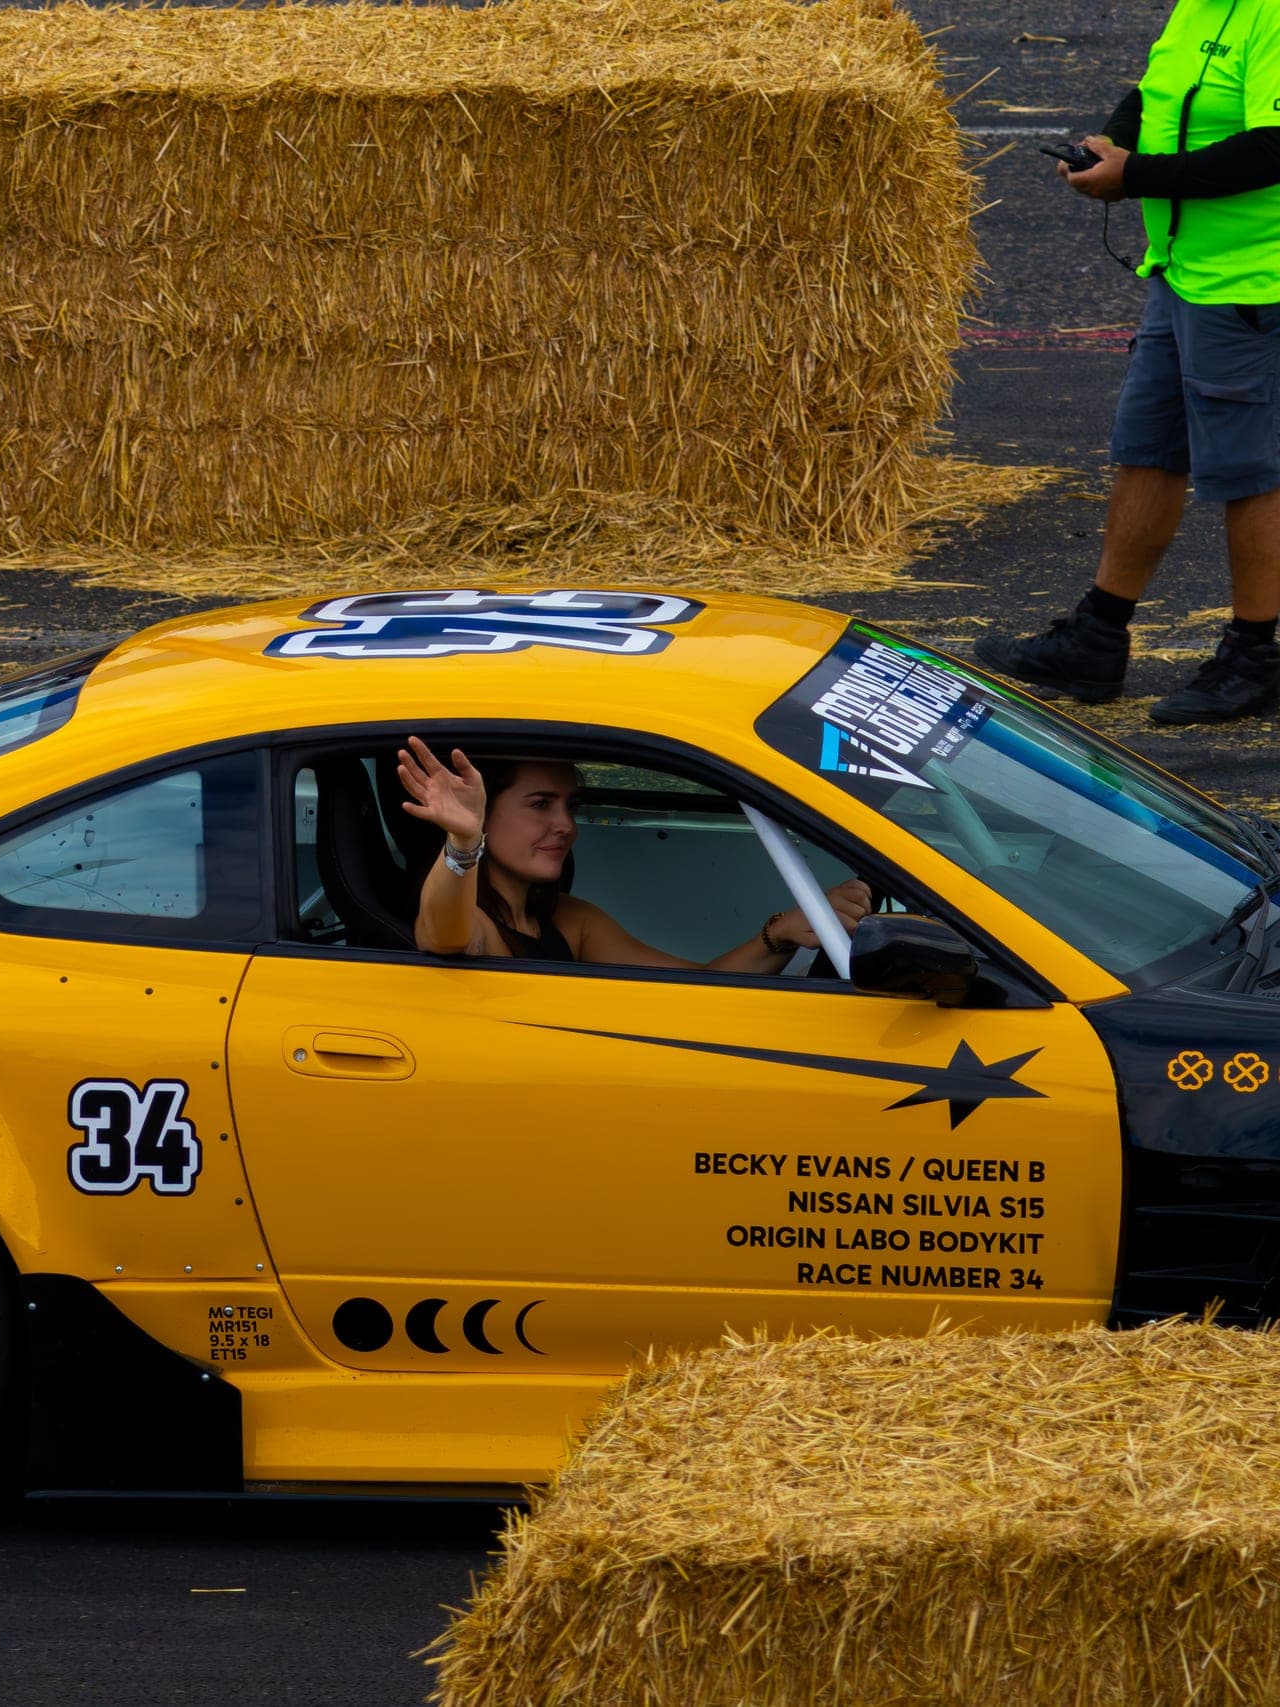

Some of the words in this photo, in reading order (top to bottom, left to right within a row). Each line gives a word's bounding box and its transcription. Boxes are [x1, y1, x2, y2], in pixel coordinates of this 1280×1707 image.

[1199, 39, 1232, 59] CREW
[70, 1081, 199, 1193] 34
[695, 1152, 787, 1176] BECKY
[797, 1155, 891, 1179] EVANS
[899, 1156, 915, 1182] /
[923, 1158, 1019, 1182] QUEEN
[1029, 1161, 1045, 1183] B
[788, 1191, 893, 1215] NISSAN
[903, 1193, 991, 1217] SILVIA
[1000, 1196, 1044, 1219] S15
[726, 1225, 826, 1249] ORIGIN
[836, 1228, 910, 1251] LABO
[919, 1230, 1044, 1254] BODYKIT
[797, 1262, 872, 1285] RACE
[881, 1265, 1001, 1289] NUMBER
[1010, 1268, 1044, 1290] 34
[208, 1306, 273, 1320] MTEGI
[209, 1320, 257, 1333] MR151
[209, 1334, 235, 1347] 9.5
[253, 1334, 270, 1347] 18
[210, 1348, 247, 1361] ET15
